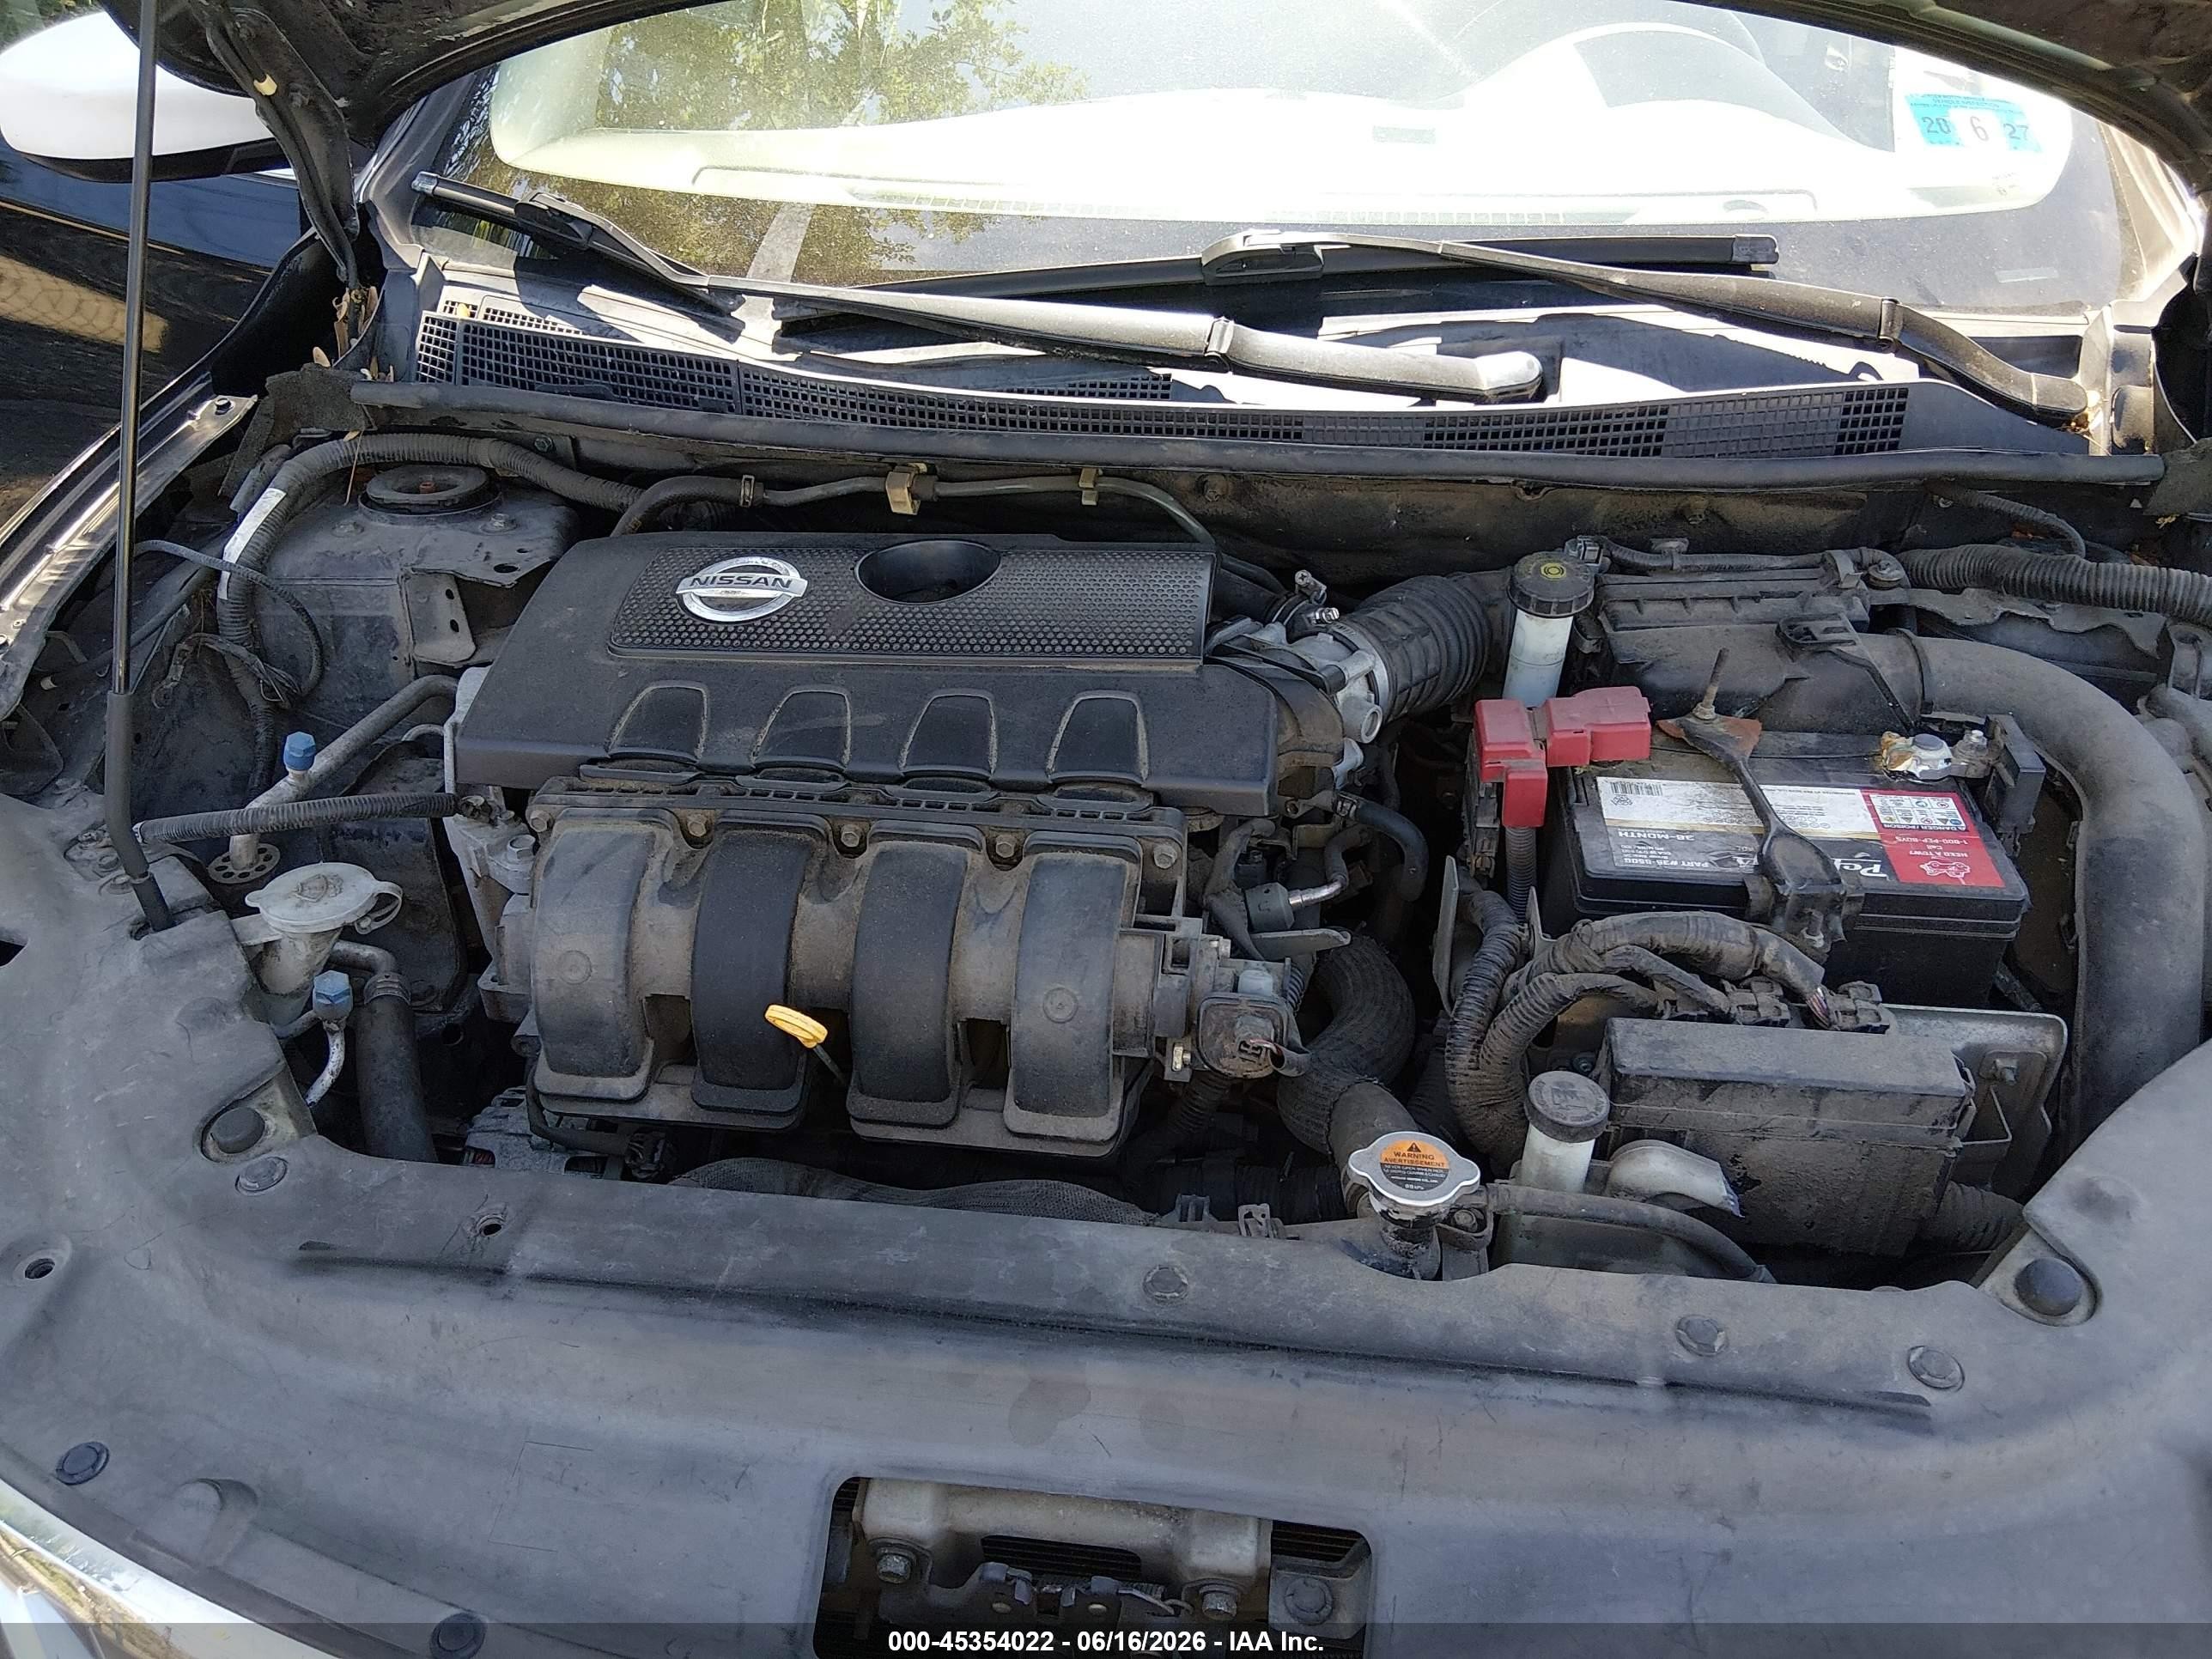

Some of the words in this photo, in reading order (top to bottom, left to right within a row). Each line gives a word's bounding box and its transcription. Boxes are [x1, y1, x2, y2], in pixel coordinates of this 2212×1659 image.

[1922, 116, 1952, 135] 20
[1970, 116, 1990, 142] 6
[2002, 123, 2029, 141] 27
[690, 575, 793, 589] NISSAN
[1895, 836, 1968, 845] 1-800-PEP-BOYS
[1394, 1151, 1435, 1161] WARNING
[1384, 1157, 1445, 1167] AVERTISSEMENT
